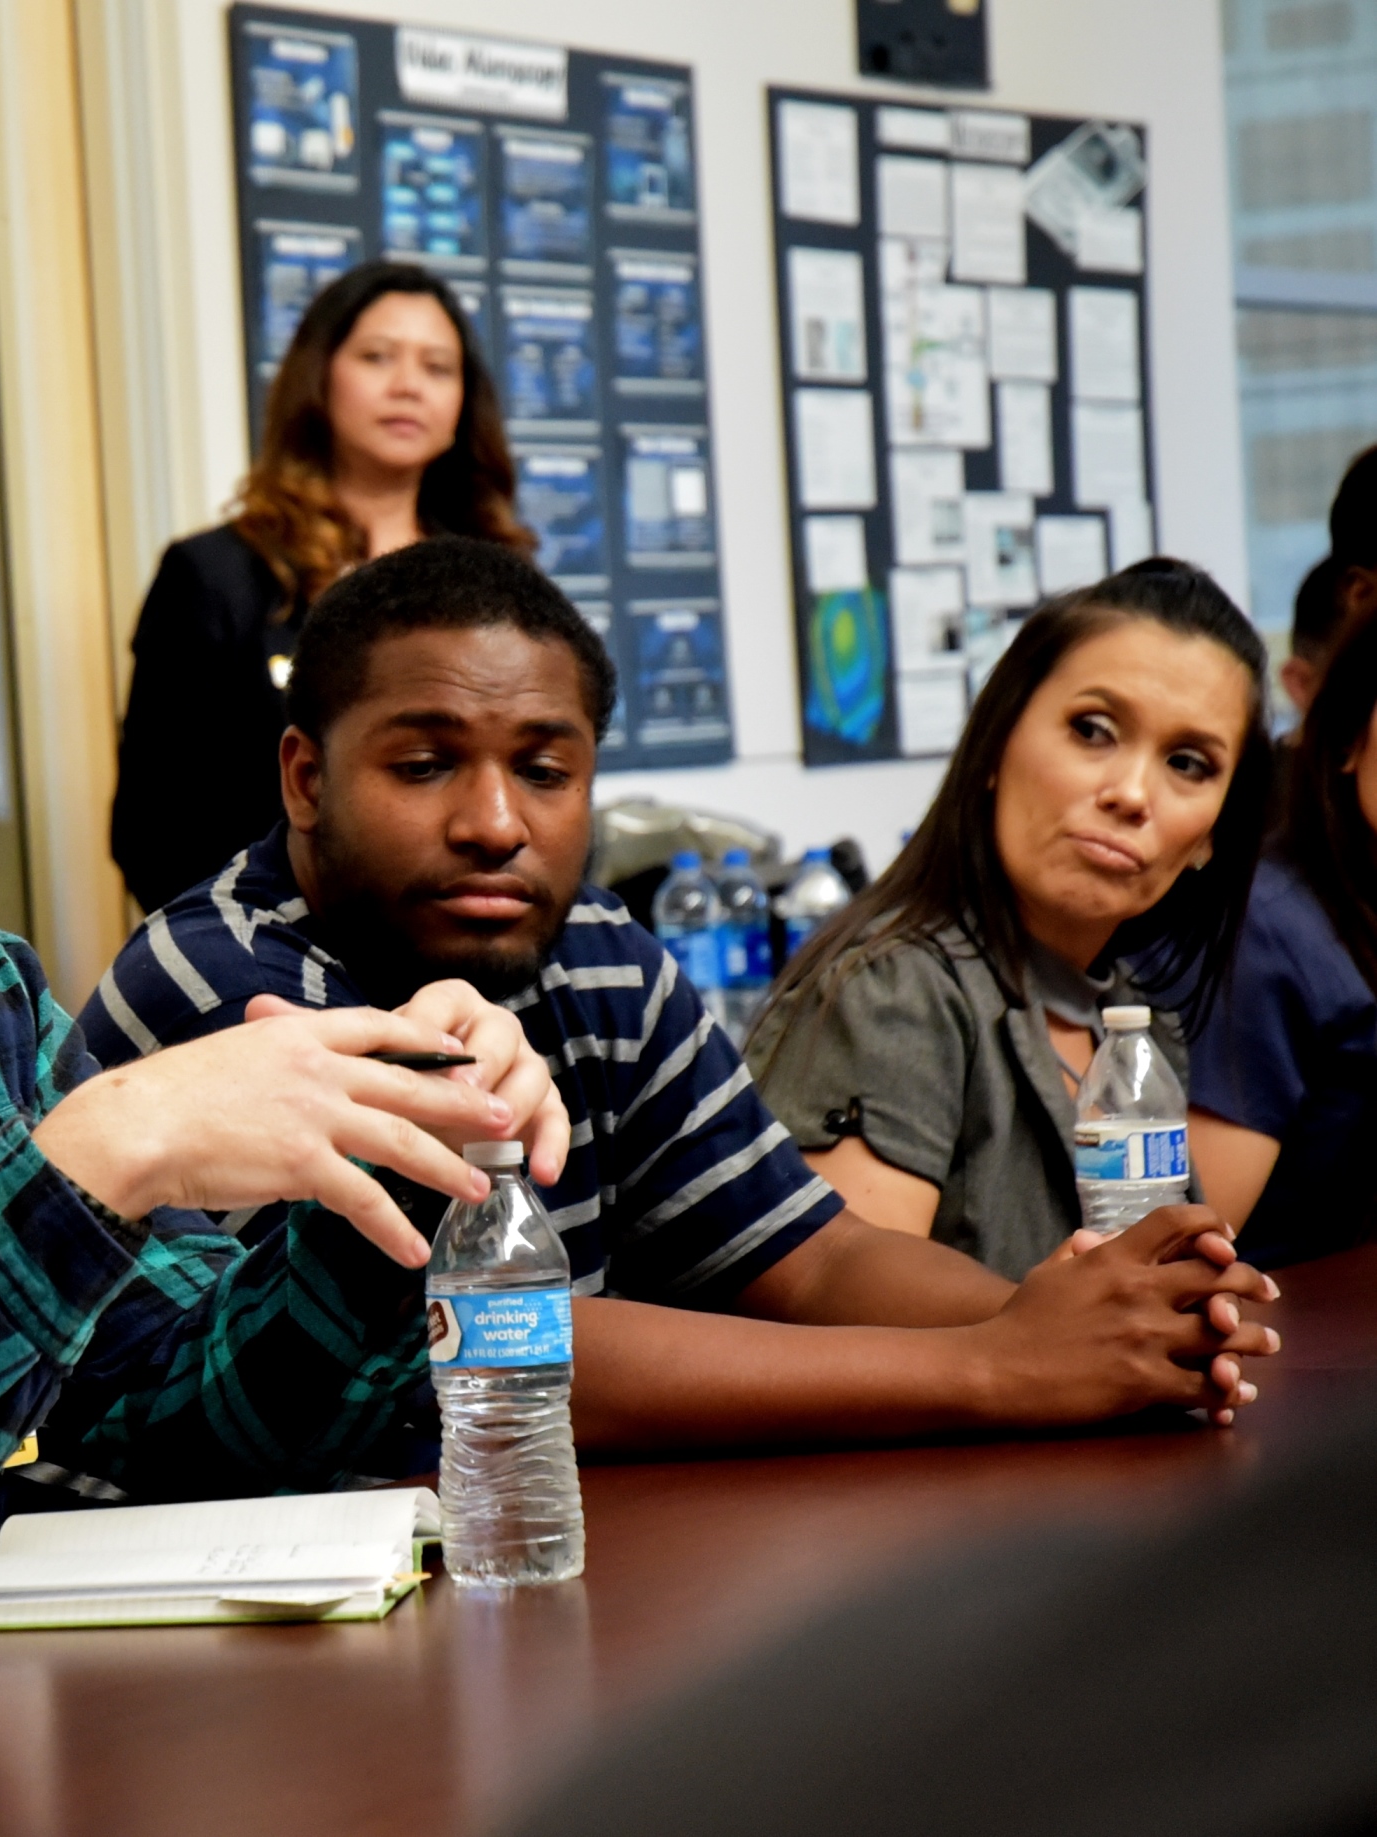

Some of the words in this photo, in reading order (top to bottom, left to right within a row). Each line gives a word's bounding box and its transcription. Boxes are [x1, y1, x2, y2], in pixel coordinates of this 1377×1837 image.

[487, 1296, 524, 1308] purified
[474, 1310, 538, 1328] drinking
[482, 1328, 532, 1342] water
